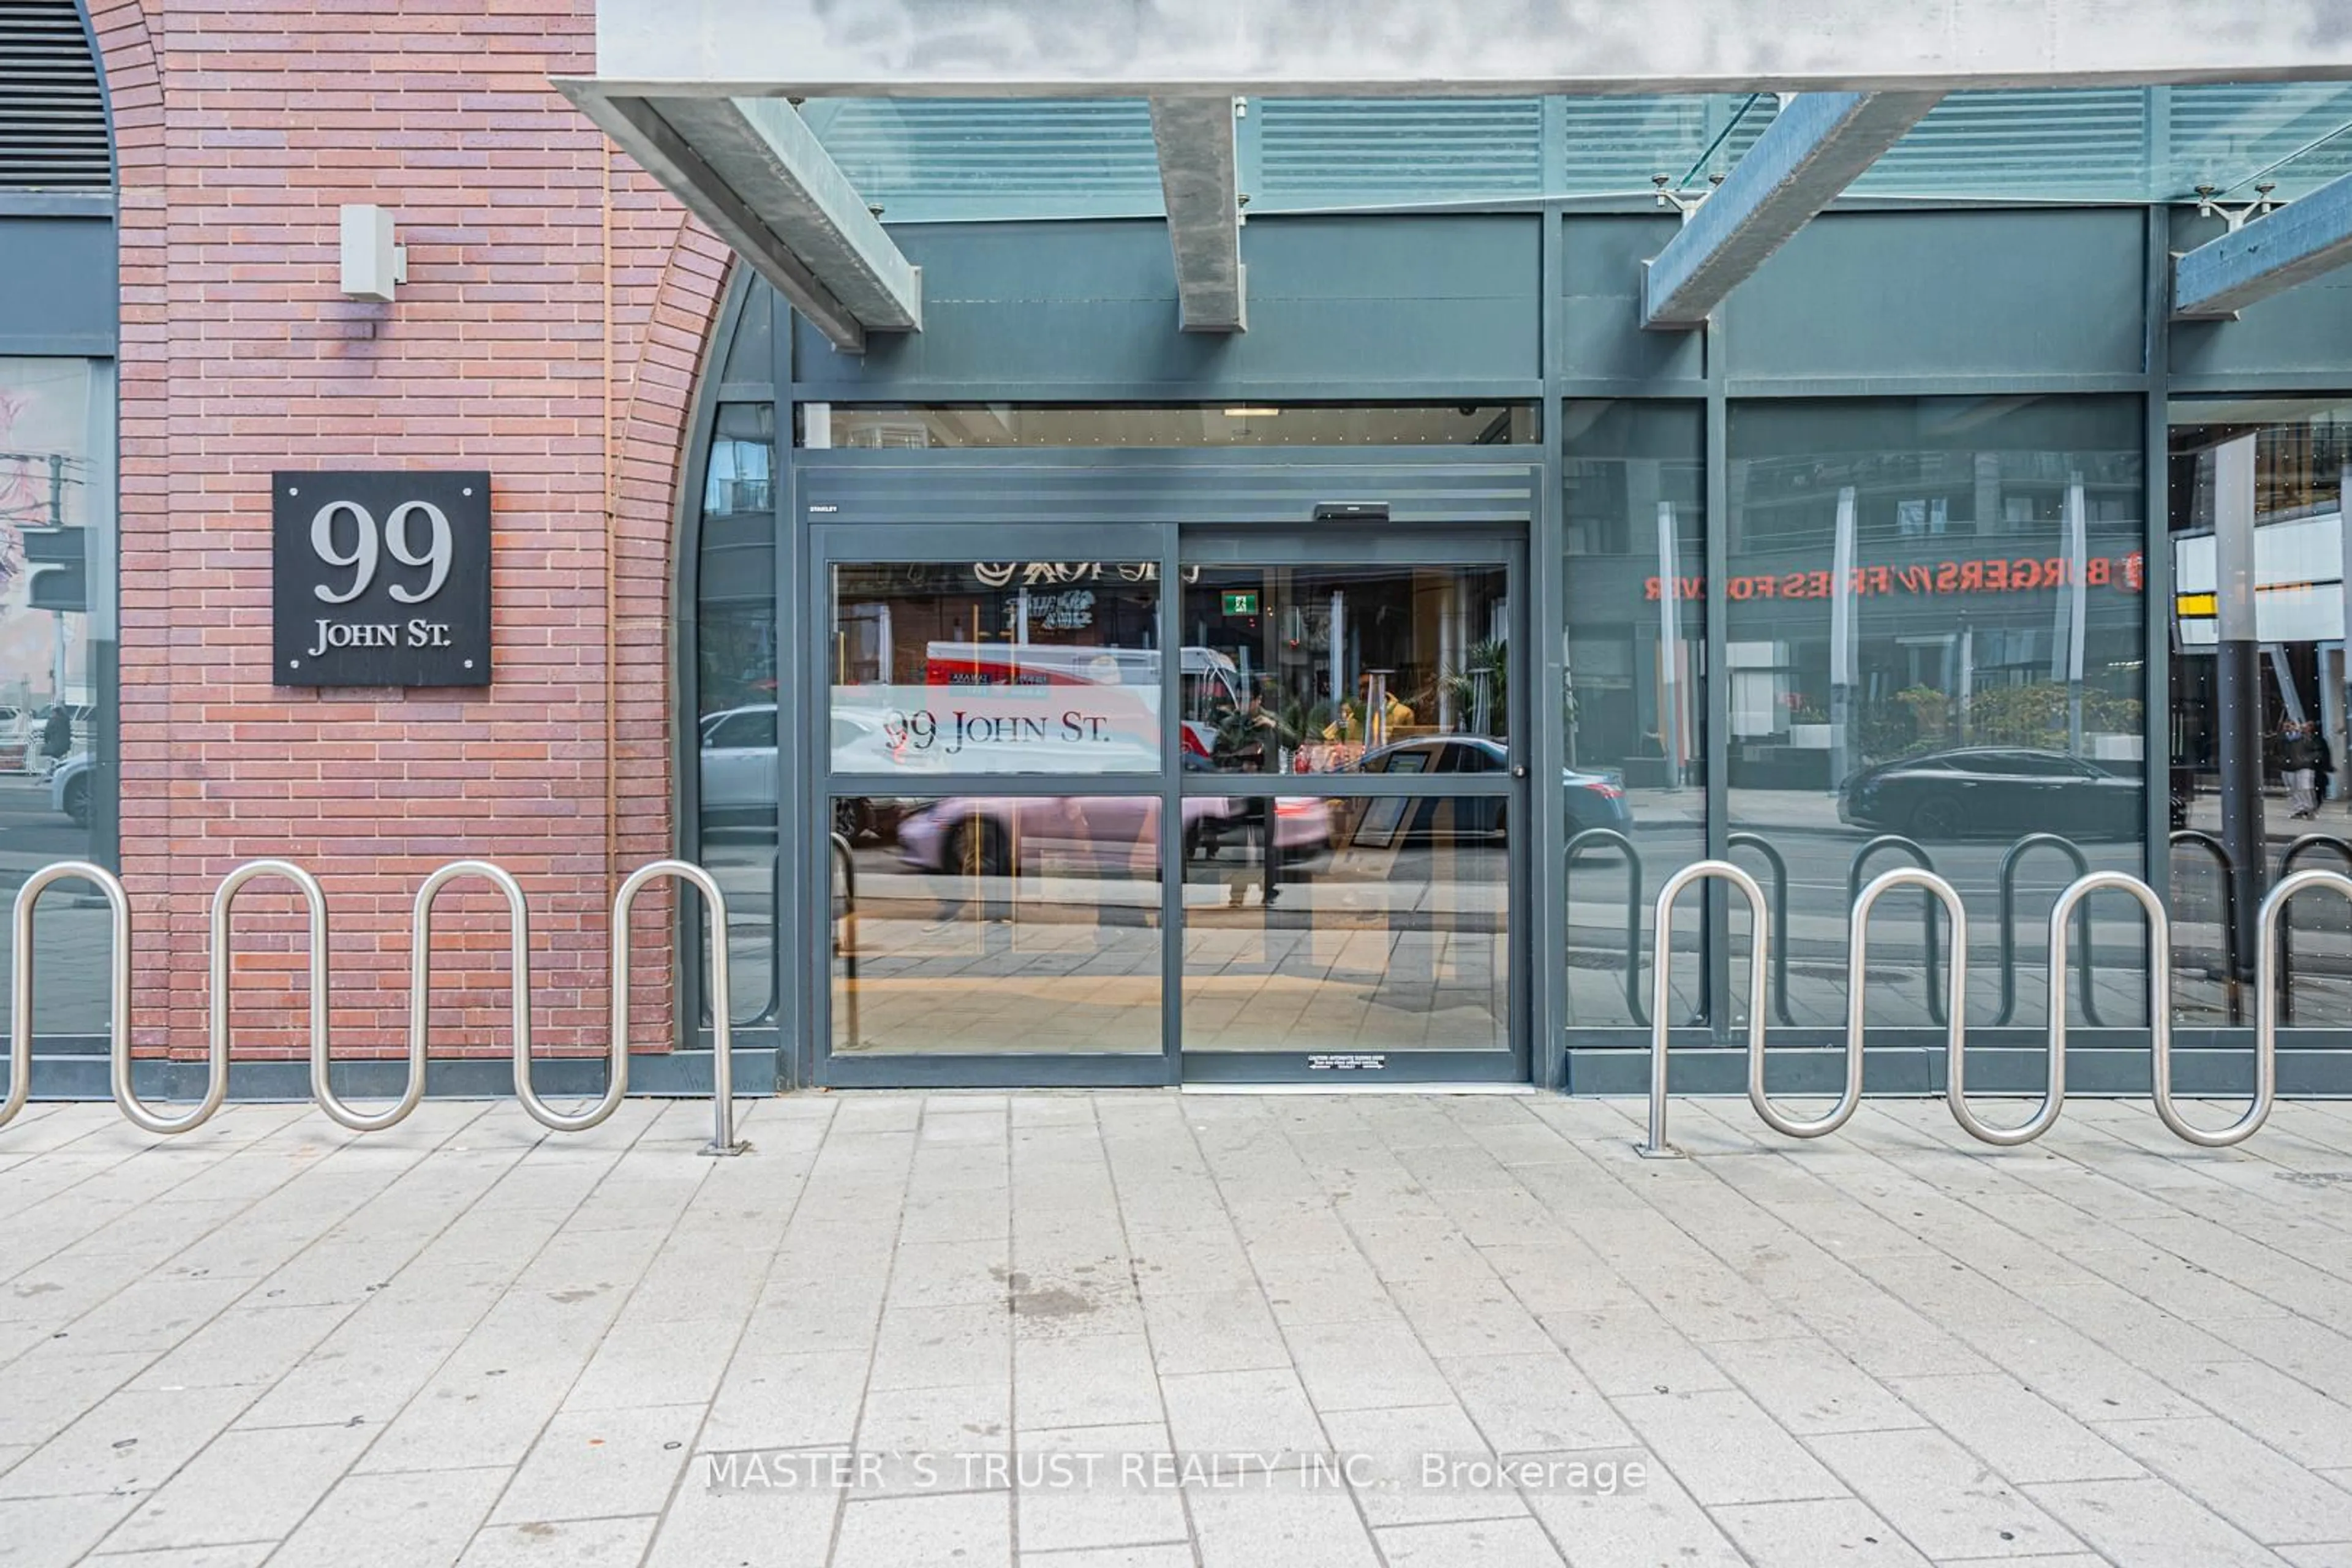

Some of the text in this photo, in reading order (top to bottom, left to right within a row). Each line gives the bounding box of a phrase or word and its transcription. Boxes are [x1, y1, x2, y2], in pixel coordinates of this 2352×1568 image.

[310, 500, 453, 604] 99
[307, 619, 400, 657] JOHN
[883, 709, 937, 750] 99
[945, 710, 1049, 755] JOHN
